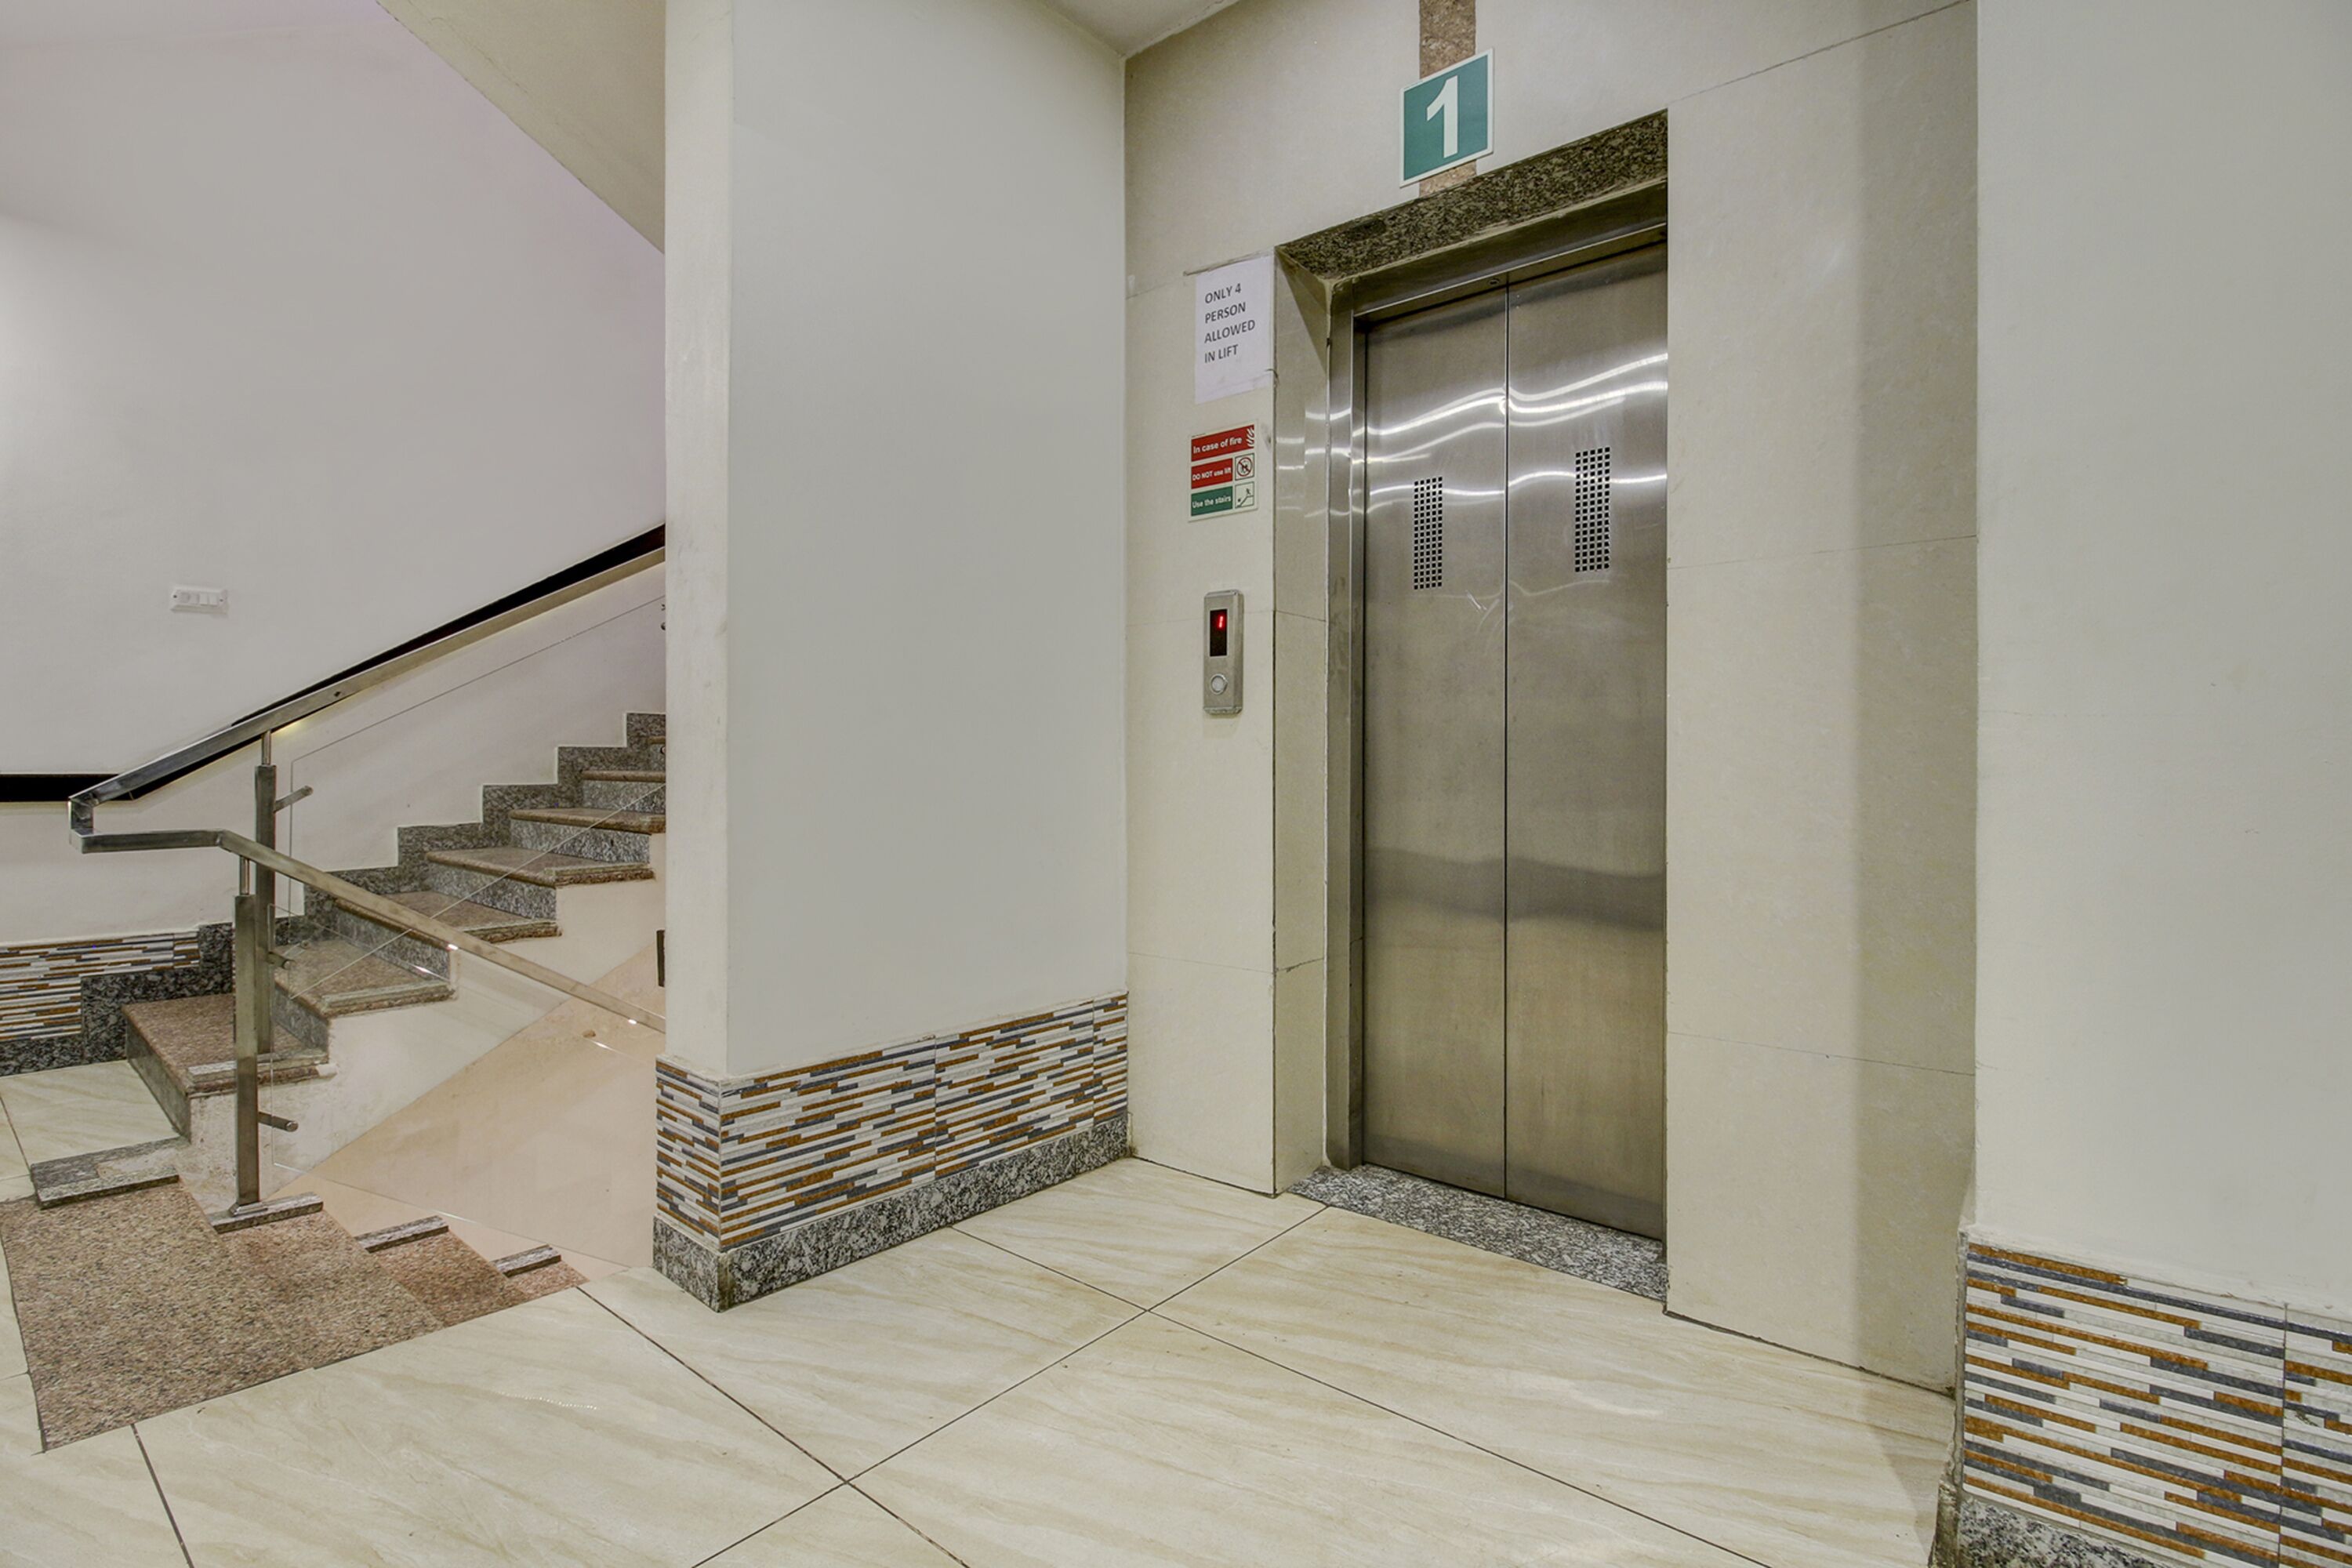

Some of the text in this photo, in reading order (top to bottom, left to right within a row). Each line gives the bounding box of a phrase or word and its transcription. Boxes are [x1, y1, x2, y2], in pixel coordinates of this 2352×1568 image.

[1426, 74, 1458, 158] 1
[1205, 283, 1241, 304] ONLY 4
[1205, 302, 1247, 324] PERSON
[1204, 319, 1255, 343] ALLOWED
[1204, 344, 1239, 363] IN LIFT
[1202, 443, 1219, 452] case
[1220, 439, 1229, 448] of
[1229, 437, 1243, 445] fire
[1215, 495, 1231, 505] stairs
